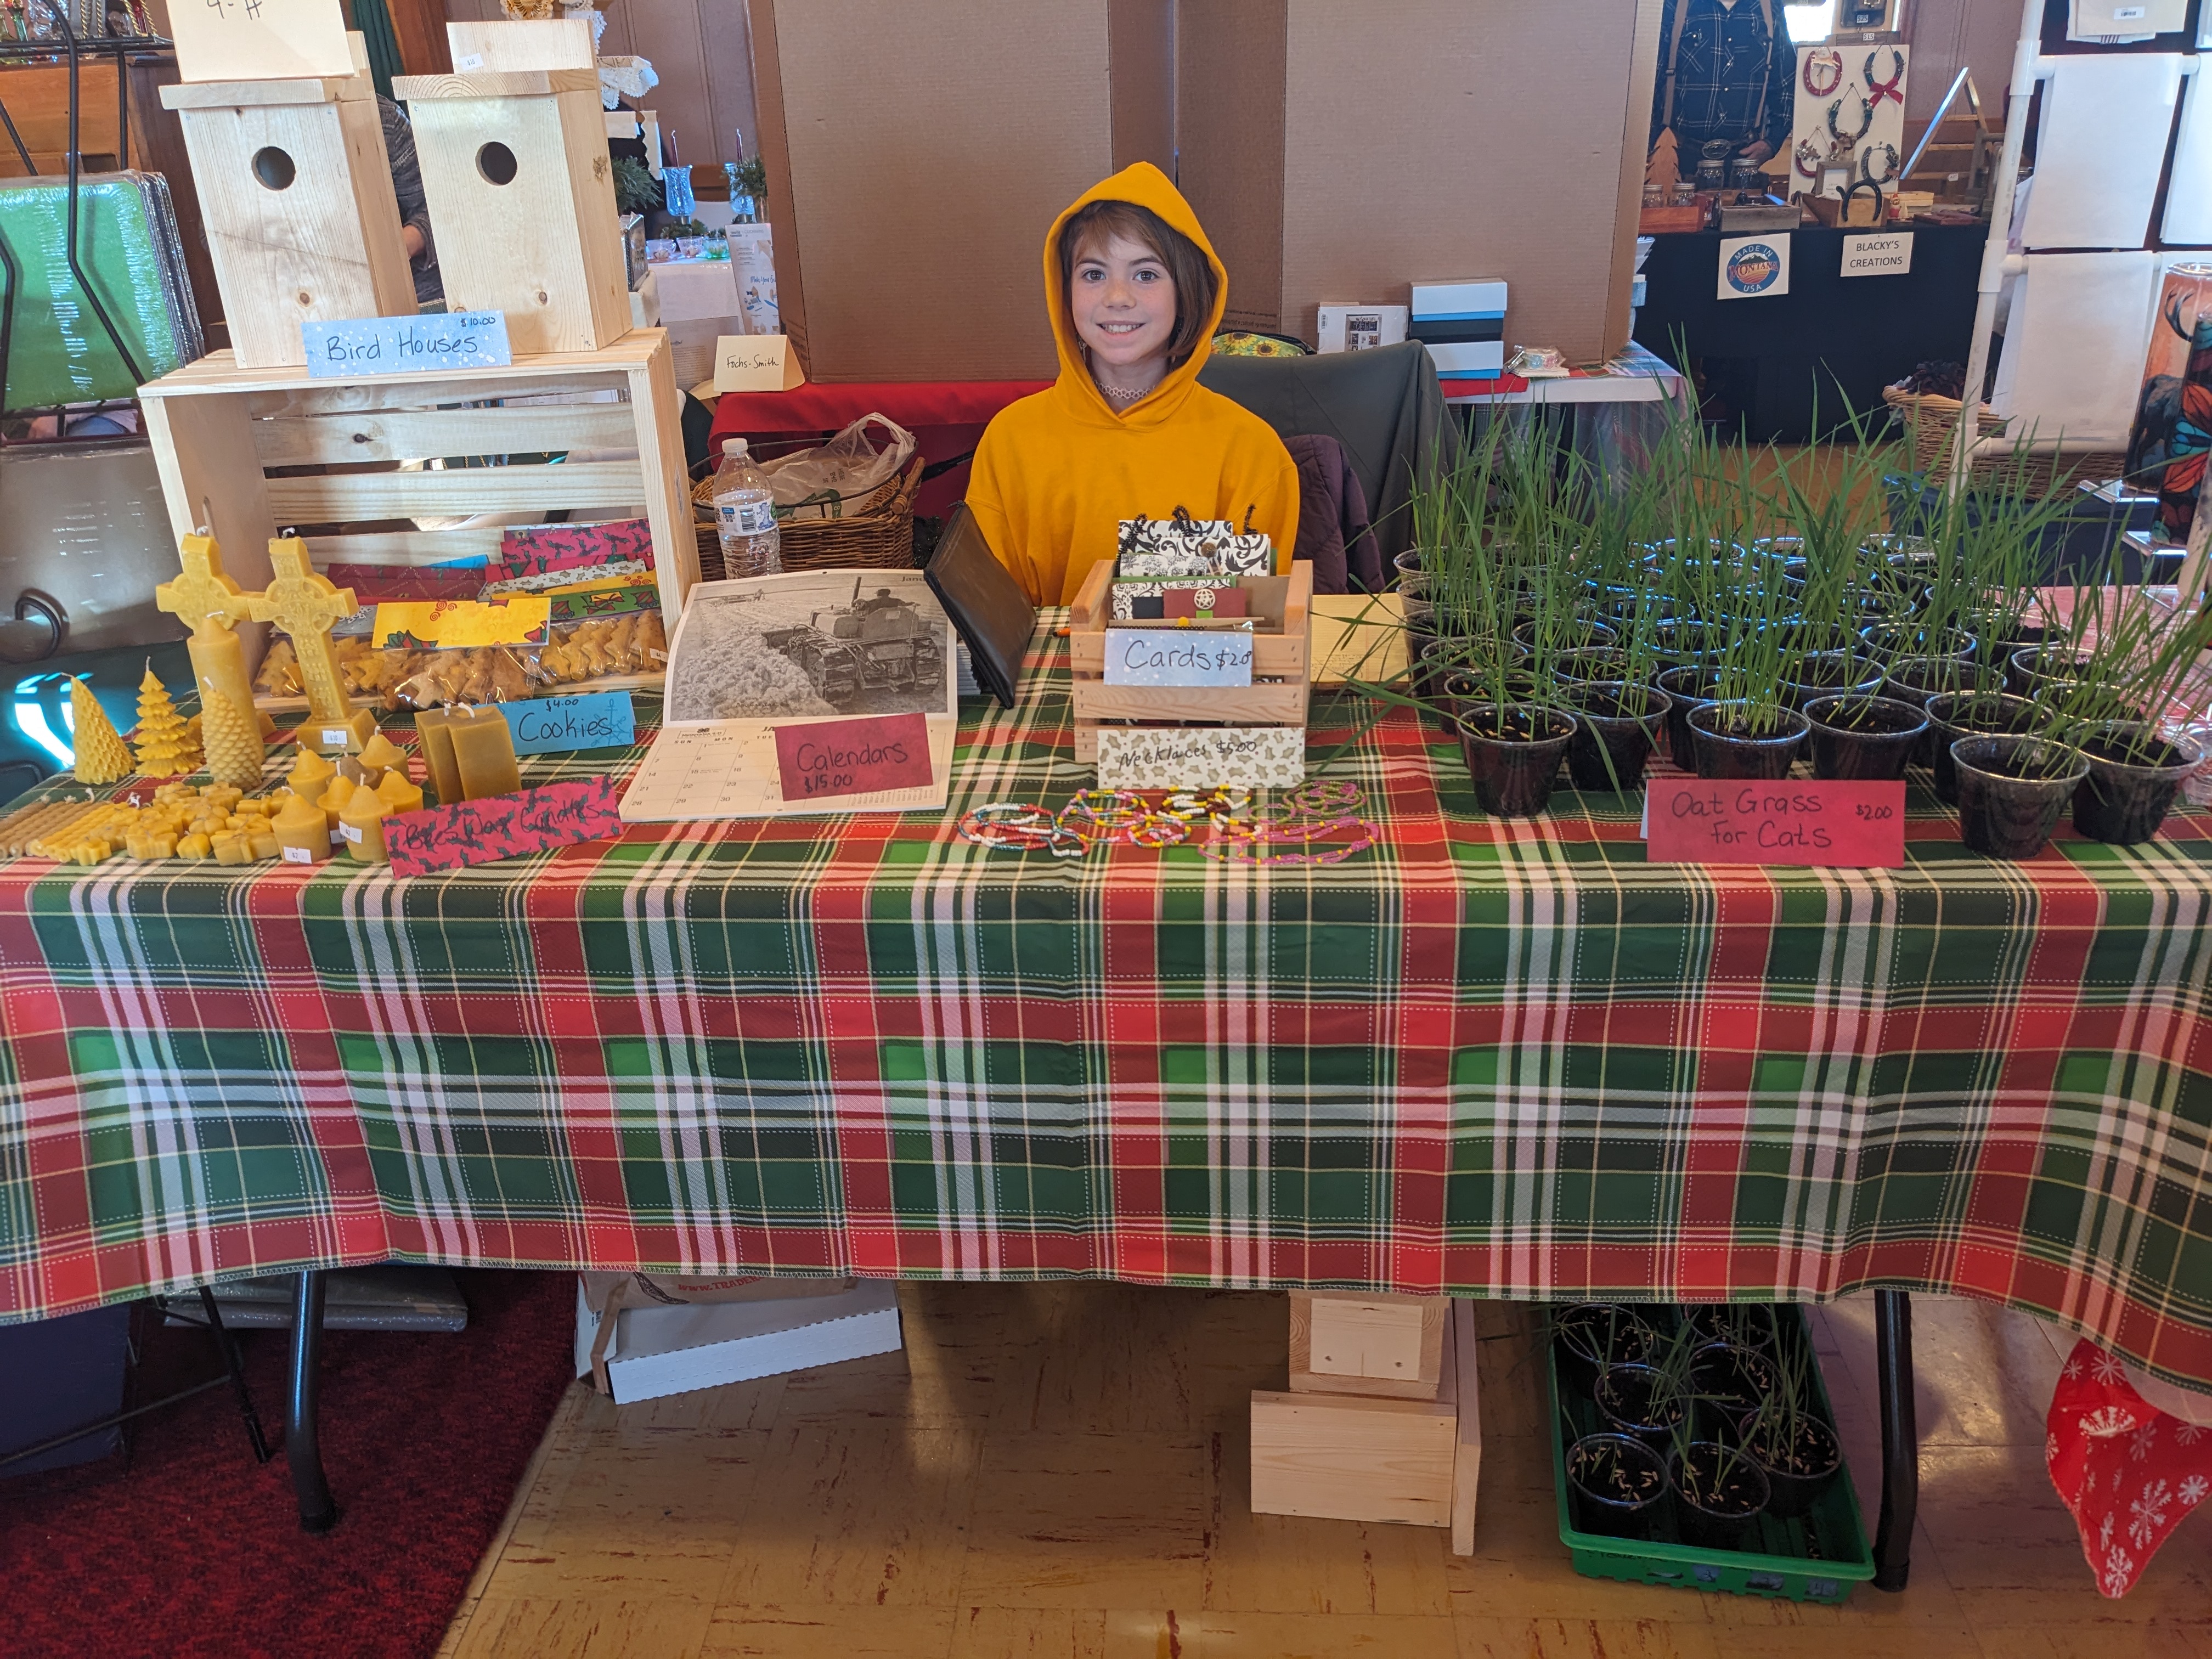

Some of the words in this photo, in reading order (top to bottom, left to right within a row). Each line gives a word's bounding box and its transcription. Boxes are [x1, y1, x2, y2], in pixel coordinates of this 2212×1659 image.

[1734, 245, 1760, 260] MADE
[1763, 247, 1773, 257] IN
[1856, 240, 1899, 251] BLACKY'S
[1850, 256, 1903, 268] CREATIONS
[1728, 261, 1779, 283] MONTANA
[460, 317, 496, 328] $10.00
[326, 334, 381, 361] Bird
[398, 326, 478, 357] Houses
[726, 354, 779, 369] Fochs-Smith
[1125, 640, 1211, 670] Cards
[546, 698, 579, 712] $4.00
[518, 710, 613, 742] Cookies
[797, 743, 907, 772] Calendars
[1119, 744, 1206, 771] Necklaces
[804, 774, 853, 793] $15.00
[1672, 792, 1723, 817] Oat
[1736, 788, 1822, 815] Grass
[1855, 804, 1892, 820] $2.00
[1758, 821, 1832, 848] Cats
[678, 1276, 765, 1291] WWW.TRADER
